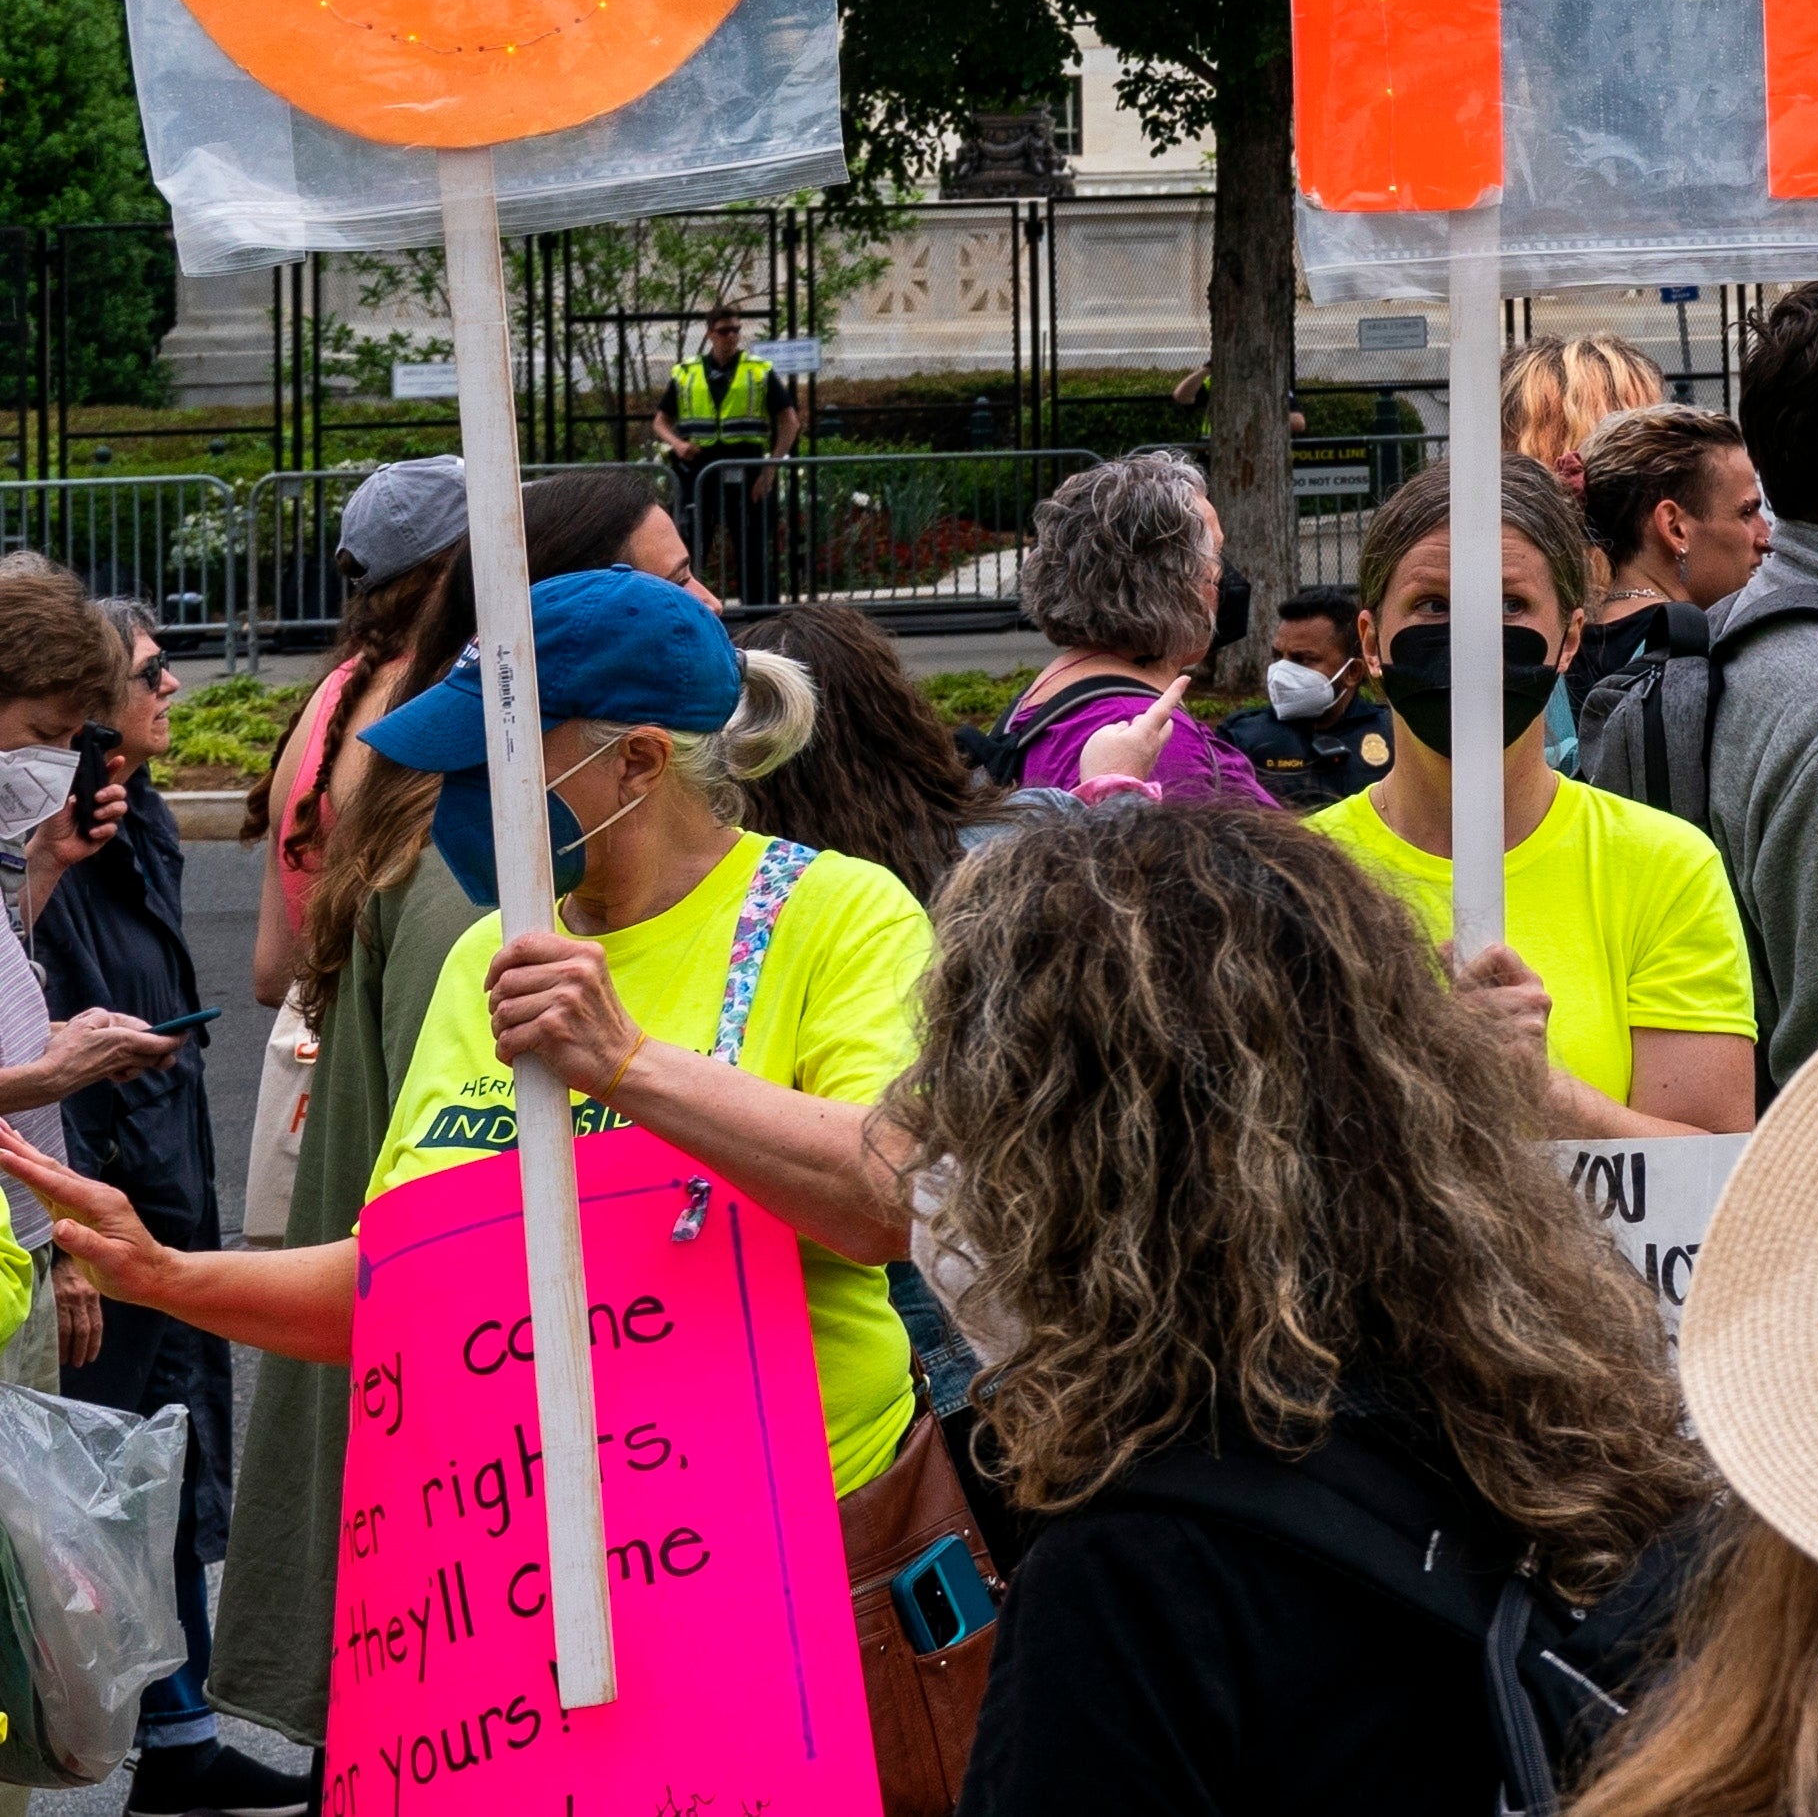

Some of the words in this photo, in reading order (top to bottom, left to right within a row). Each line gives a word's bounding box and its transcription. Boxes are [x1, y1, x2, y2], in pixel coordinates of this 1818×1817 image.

[1292, 449, 1335, 462] POLICE
[1339, 447, 1367, 461] LINE
[1309, 476, 1331, 486] NOT
[1334, 474, 1369, 487] CROSS
